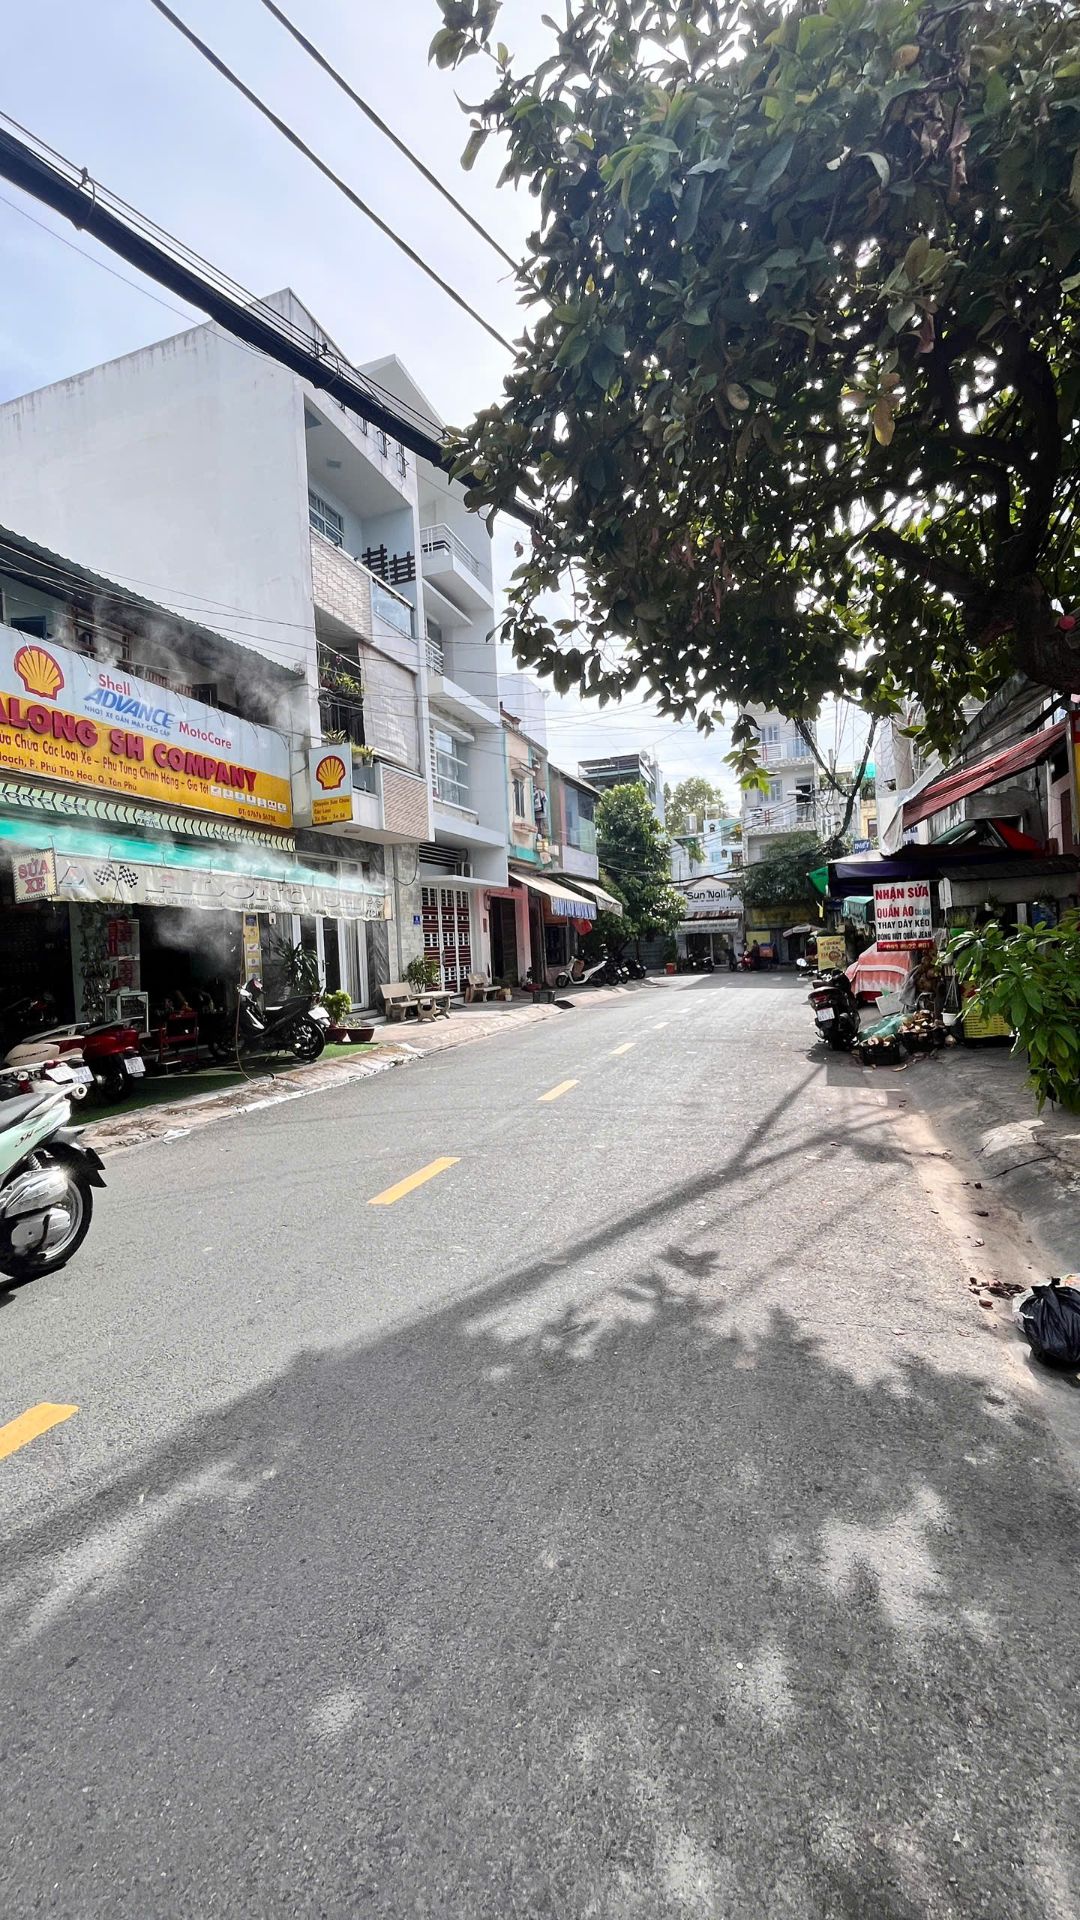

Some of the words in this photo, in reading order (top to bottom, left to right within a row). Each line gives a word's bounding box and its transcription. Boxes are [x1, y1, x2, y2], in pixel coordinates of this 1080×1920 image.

[99, 674, 130, 696] Shell
[83, 688, 175, 729] ADVANCE
[178, 721, 232, 750] MotoCare
[80, 750, 92, 765] Xe
[110, 728, 145, 762] SH
[153, 743, 257, 792] COMPANY
[18, 857, 50, 879] SỬA
[25, 876, 46, 894] XE
[875, 886, 905, 901] NHẬN
[907, 883, 929, 898] SỬA
[686, 891, 705, 900] Sun
[902, 904, 914, 917] ÁO
[878, 920, 896, 930] THAY
[898, 919, 913, 928] DÂY
[915, 917, 930, 927] KÉO
[919, 931, 932, 939] JEAN
